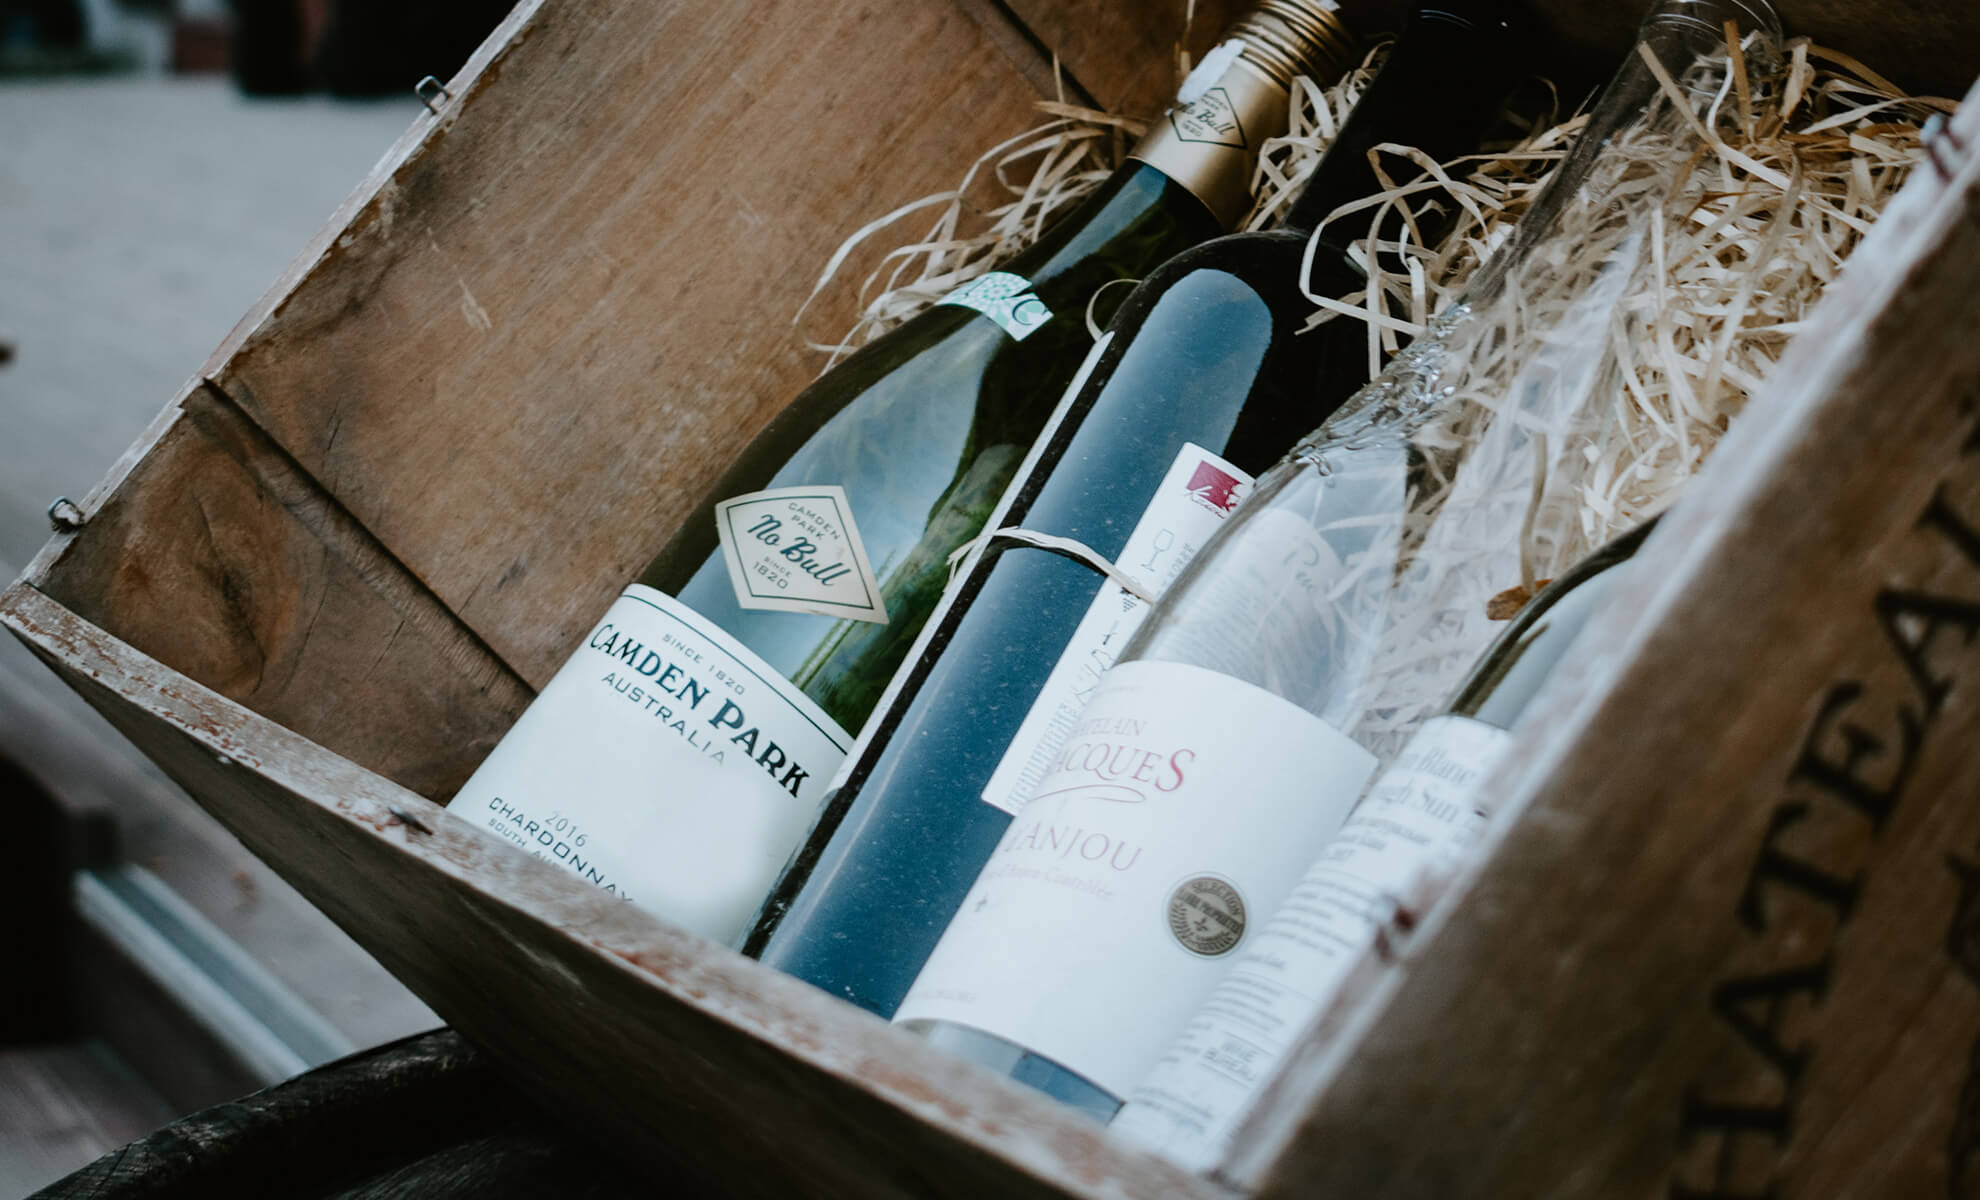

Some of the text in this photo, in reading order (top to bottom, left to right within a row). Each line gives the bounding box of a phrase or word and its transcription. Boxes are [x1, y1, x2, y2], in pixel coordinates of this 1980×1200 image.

[1196, 108, 1235, 136] Bull
[787, 501, 842, 541] CAMDEN
[791, 514, 826, 541] PARK
[747, 513, 852, 587] No Bull
[763, 555, 793, 579] SINCE
[752, 561, 789, 590] 1820
[662, 633, 746, 696] SINCE 1820
[590, 623, 811, 799] CAMDEN PARK
[601, 671, 727, 767] AUSTRALIA
[487, 817, 528, 848] SOUTH
[544, 810, 590, 848] 2016
